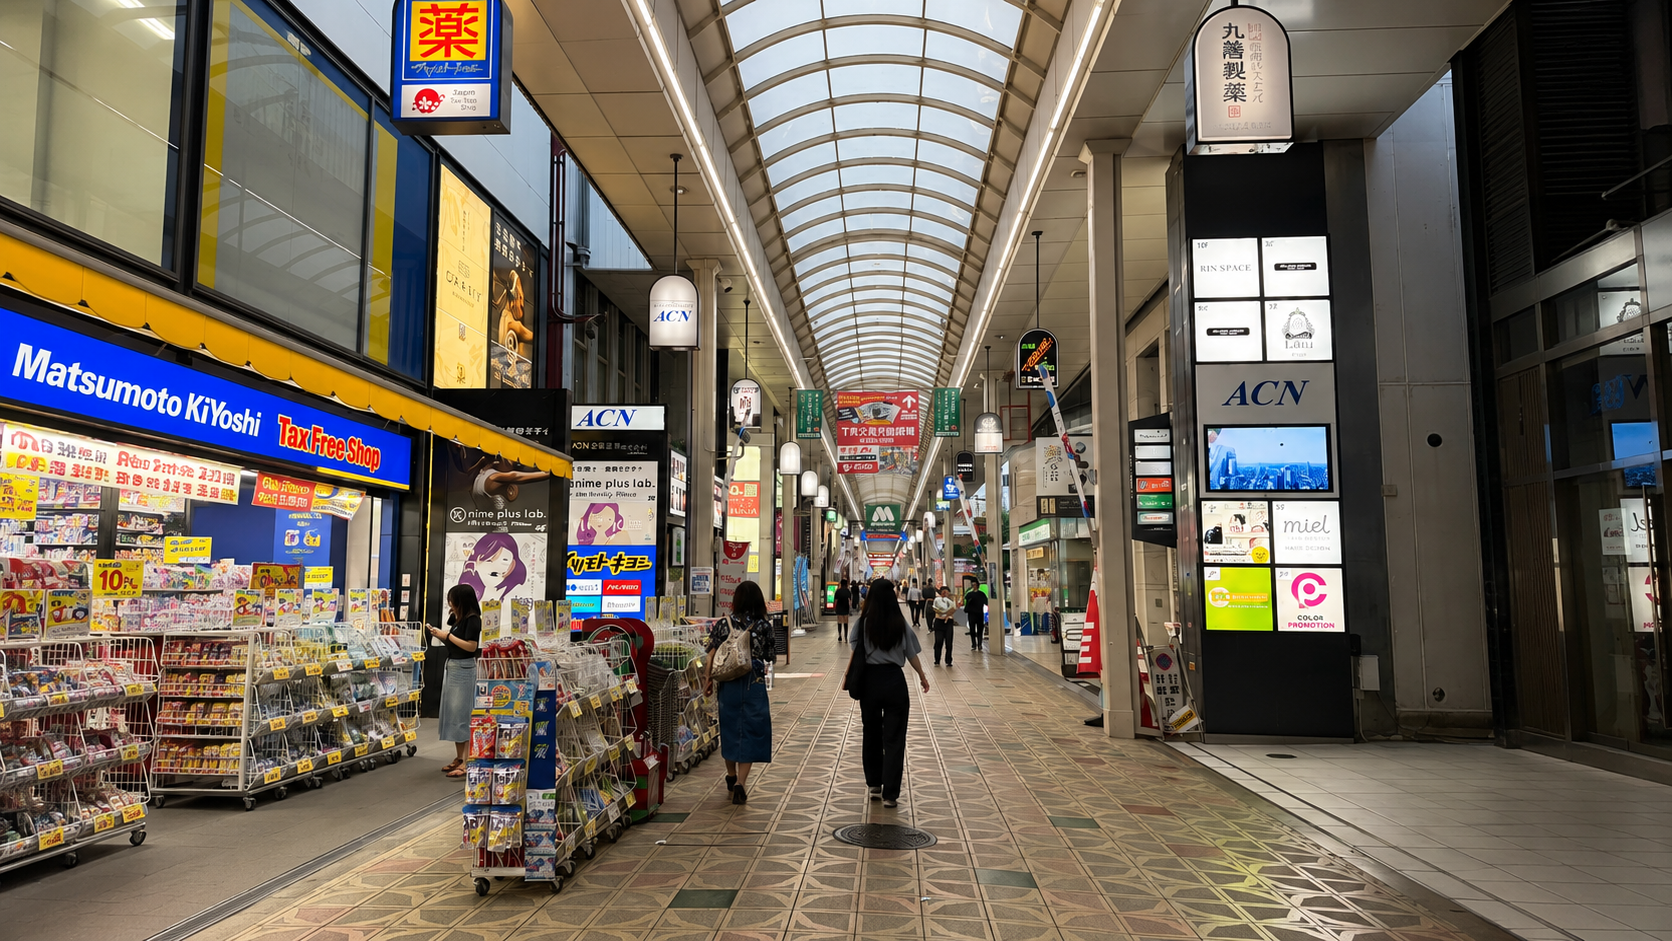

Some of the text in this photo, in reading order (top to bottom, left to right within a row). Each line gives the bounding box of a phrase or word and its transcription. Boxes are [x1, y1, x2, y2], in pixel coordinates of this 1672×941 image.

[419, 3, 479, 58] 薬
[1200, 263, 1252, 272] RIN SPACE
[653, 310, 692, 323] ACN
[11, 342, 262, 438] Matsumoto KiYoshi
[1222, 380, 1310, 407] ACN
[576, 408, 637, 427] ACN
[277, 413, 382, 474] Tax Free Shop
[605, 478, 630, 490] plus
[633, 478, 656, 489] lab.
[497, 508, 522, 520] plus
[524, 508, 547, 519] lab.
[1283, 514, 1331, 534] miel
[1287, 621, 1335, 629] PROMOTION
